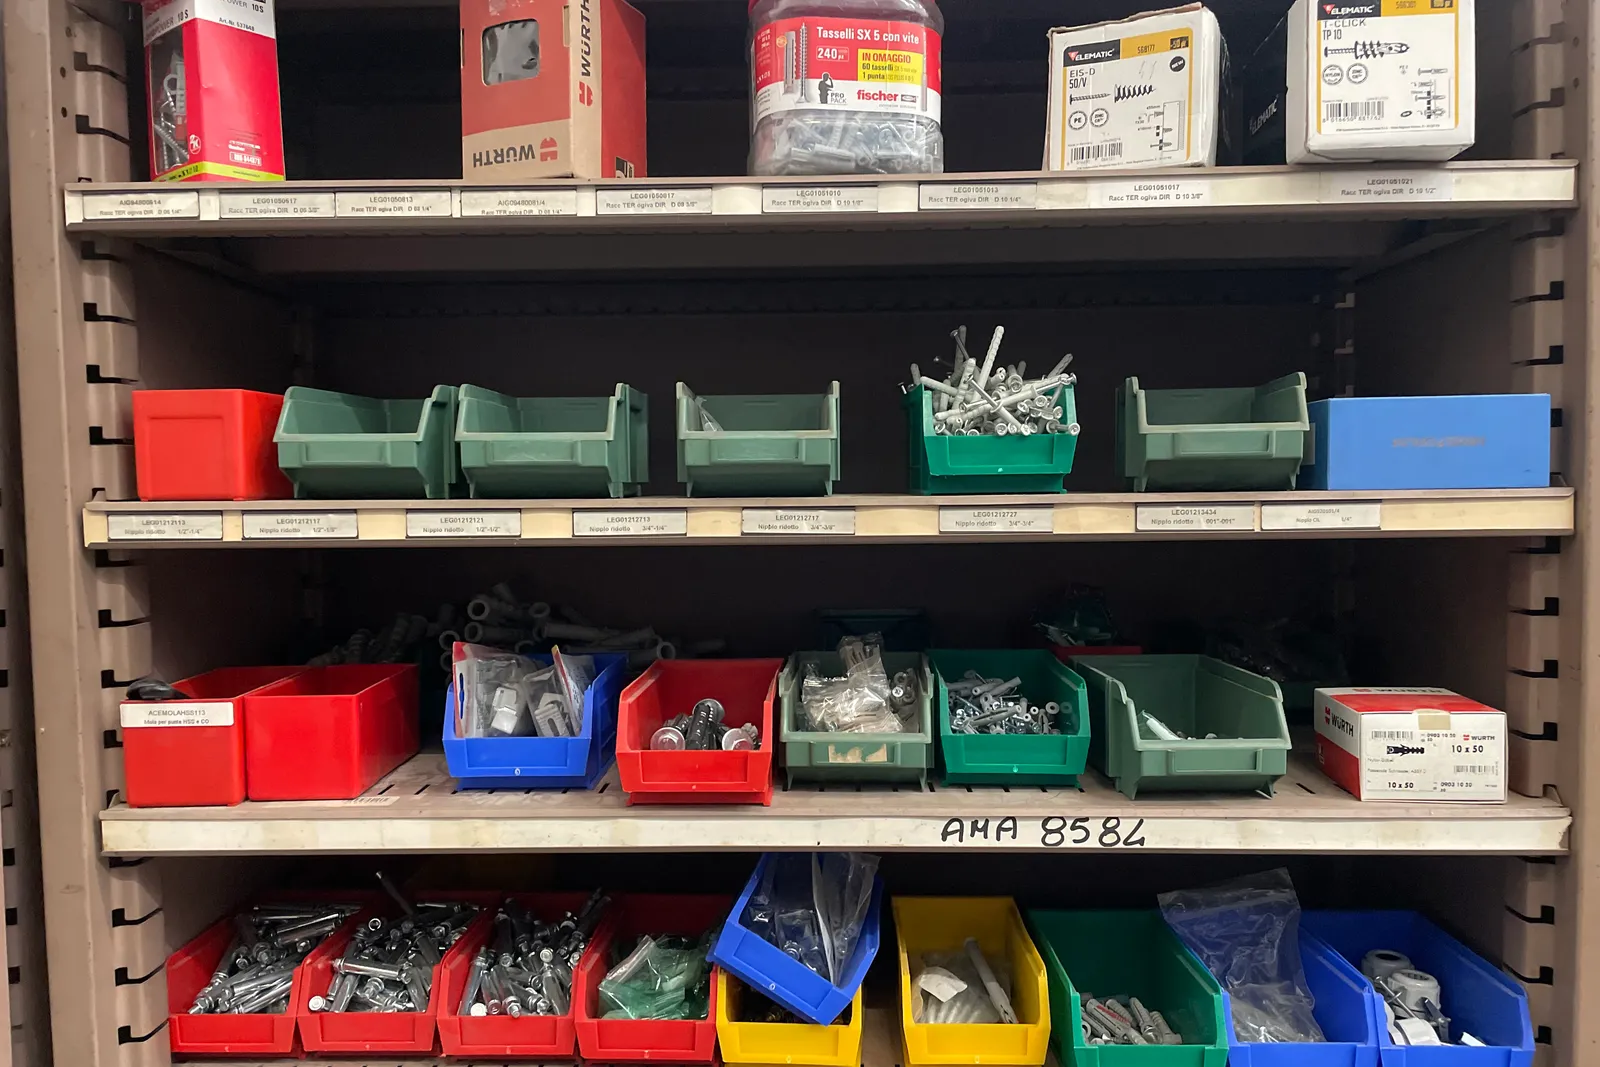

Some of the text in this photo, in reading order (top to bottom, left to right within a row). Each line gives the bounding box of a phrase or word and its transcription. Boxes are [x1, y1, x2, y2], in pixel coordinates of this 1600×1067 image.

[1331, 5, 1374, 15] ELEMATIC
[1323, 17, 1366, 29] T-CLICK
[816, 26, 920, 45] Tasselli SX 5 con vite
[1323, 29, 1342, 40] TP 10
[817, 48, 838, 60] 240
[862, 52, 911, 64] IN OMAGGIO
[1075, 50, 1113, 61] ELEMATIC
[867, 73, 885, 81] punta
[1069, 68, 1096, 78] EIS-D
[1069, 77, 1087, 89] 50/V
[857, 90, 898, 102] fischer
[473, 145, 535, 167] WÜRTH
[1134, 184, 1180, 192] LEG01051017
[1331, 713, 1354, 737] WÜRTH
[1452, 745, 1462, 753] 10
[1472, 745, 1484, 753] 50
